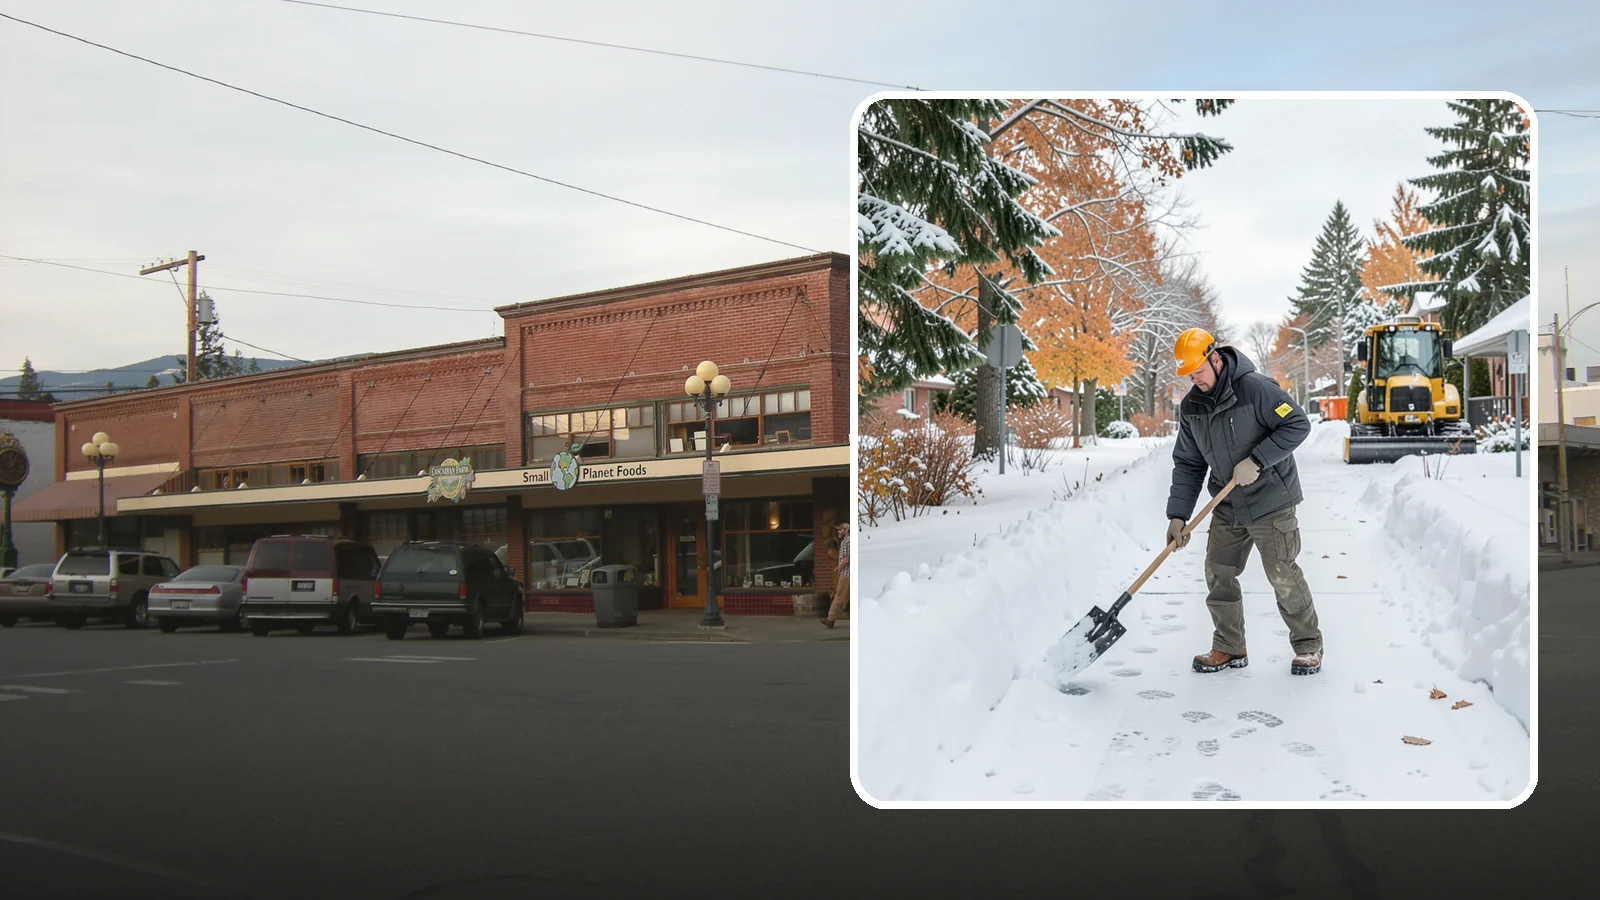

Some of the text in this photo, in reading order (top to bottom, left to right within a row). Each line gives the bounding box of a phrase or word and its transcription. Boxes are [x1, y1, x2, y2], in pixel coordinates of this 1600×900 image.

[523, 464, 647, 483] Small Planet Foods
